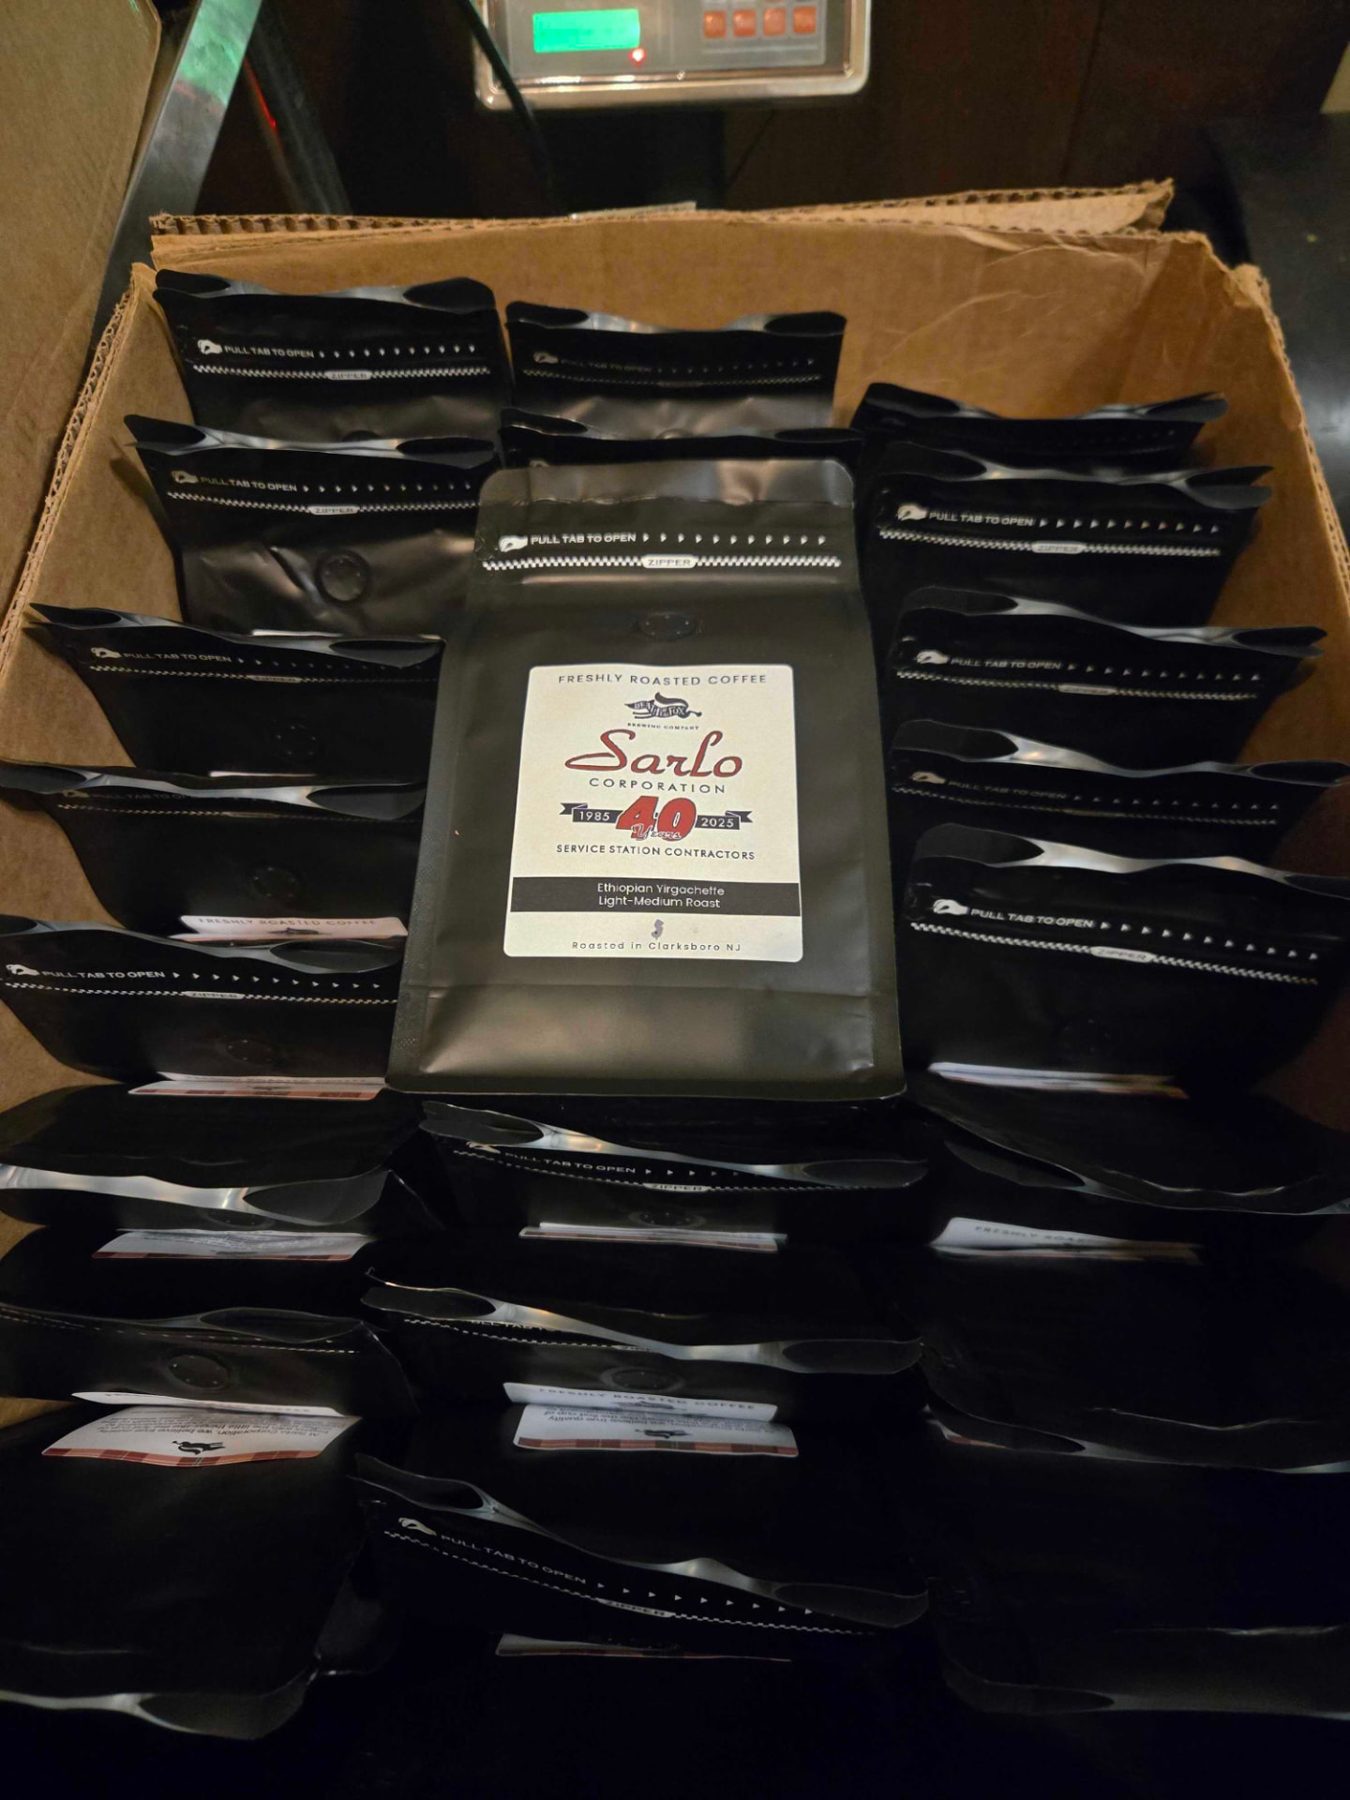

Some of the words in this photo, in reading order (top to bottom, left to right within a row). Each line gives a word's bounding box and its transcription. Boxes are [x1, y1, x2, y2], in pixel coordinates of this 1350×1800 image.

[224, 345, 249, 355] PULL
[250, 347, 271, 356] TAB
[271, 348, 286, 357] TO
[286, 349, 315, 358] OPEN
[200, 476, 228, 486] PULL
[229, 479, 251, 488] TAB
[251, 481, 266, 490] TO
[267, 482, 298, 492] OPEN
[929, 511, 958, 522] PULL
[960, 513, 983, 524] TAB
[985, 515, 1000, 525] TO
[1001, 516, 1034, 527] OPEN
[530, 535, 560, 545] PULL
[562, 534, 585, 544] TAB
[586, 534, 603, 543] TO
[603, 533, 637, 543] OPEN
[647, 558, 692, 567] ZIPPER
[123, 652, 153, 660] PULL
[199, 654, 232, 663] OPEN
[951, 658, 982, 667] PULL
[984, 660, 1008, 668] TAB
[1010, 661, 1026, 669] TO
[1027, 661, 1062, 670] OPEN
[559, 674, 623, 684] FRESHLY
[630, 675, 701, 686] ROASTED
[708, 674, 767, 685] COFFEE
[564, 729, 743, 778] Sarlo
[589, 778, 726, 793] CORPORATION
[948, 780, 980, 791] PULL
[984, 785, 1010, 794] TAB
[1012, 788, 1029, 796] TO
[1030, 790, 1067, 800] OPEN
[579, 811, 611, 821] 1985
[615, 795, 697, 842] 40
[701, 817, 735, 828] 2025
[632, 823, 683, 841] Years
[556, 845, 606, 854] SERVICE
[609, 846, 661, 855] STATION
[664, 848, 755, 860] CONTRACTORS
[597, 883, 654, 895] Ethiopian
[598, 895, 683, 908] Light-Medium
[686, 898, 721, 908] Roast
[971, 908, 1005, 921] PULL
[1007, 912, 1035, 923] TAB
[1037, 915, 1054, 925] TO
[1055, 917, 1095, 928] OPEN
[572, 941, 625, 950] Roasted
[631, 942, 642, 950] in
[648, 942, 721, 951] Clarksboro
[726, 944, 741, 952] NJ
[41, 970, 77, 978] PULL
[77, 971, 105, 979] TAB
[106, 971, 125, 979] TO
[126, 970, 166, 979] OPEN
[505, 1152, 542, 1162] PULL
[543, 1158, 572, 1167] TAB
[595, 1164, 637, 1174] OPEN
[441, 1534, 482, 1551] PULL
[483, 1547, 516, 1561] TAB
[518, 1558, 539, 1569] TO
[542, 1566, 587, 1585] OPEN
